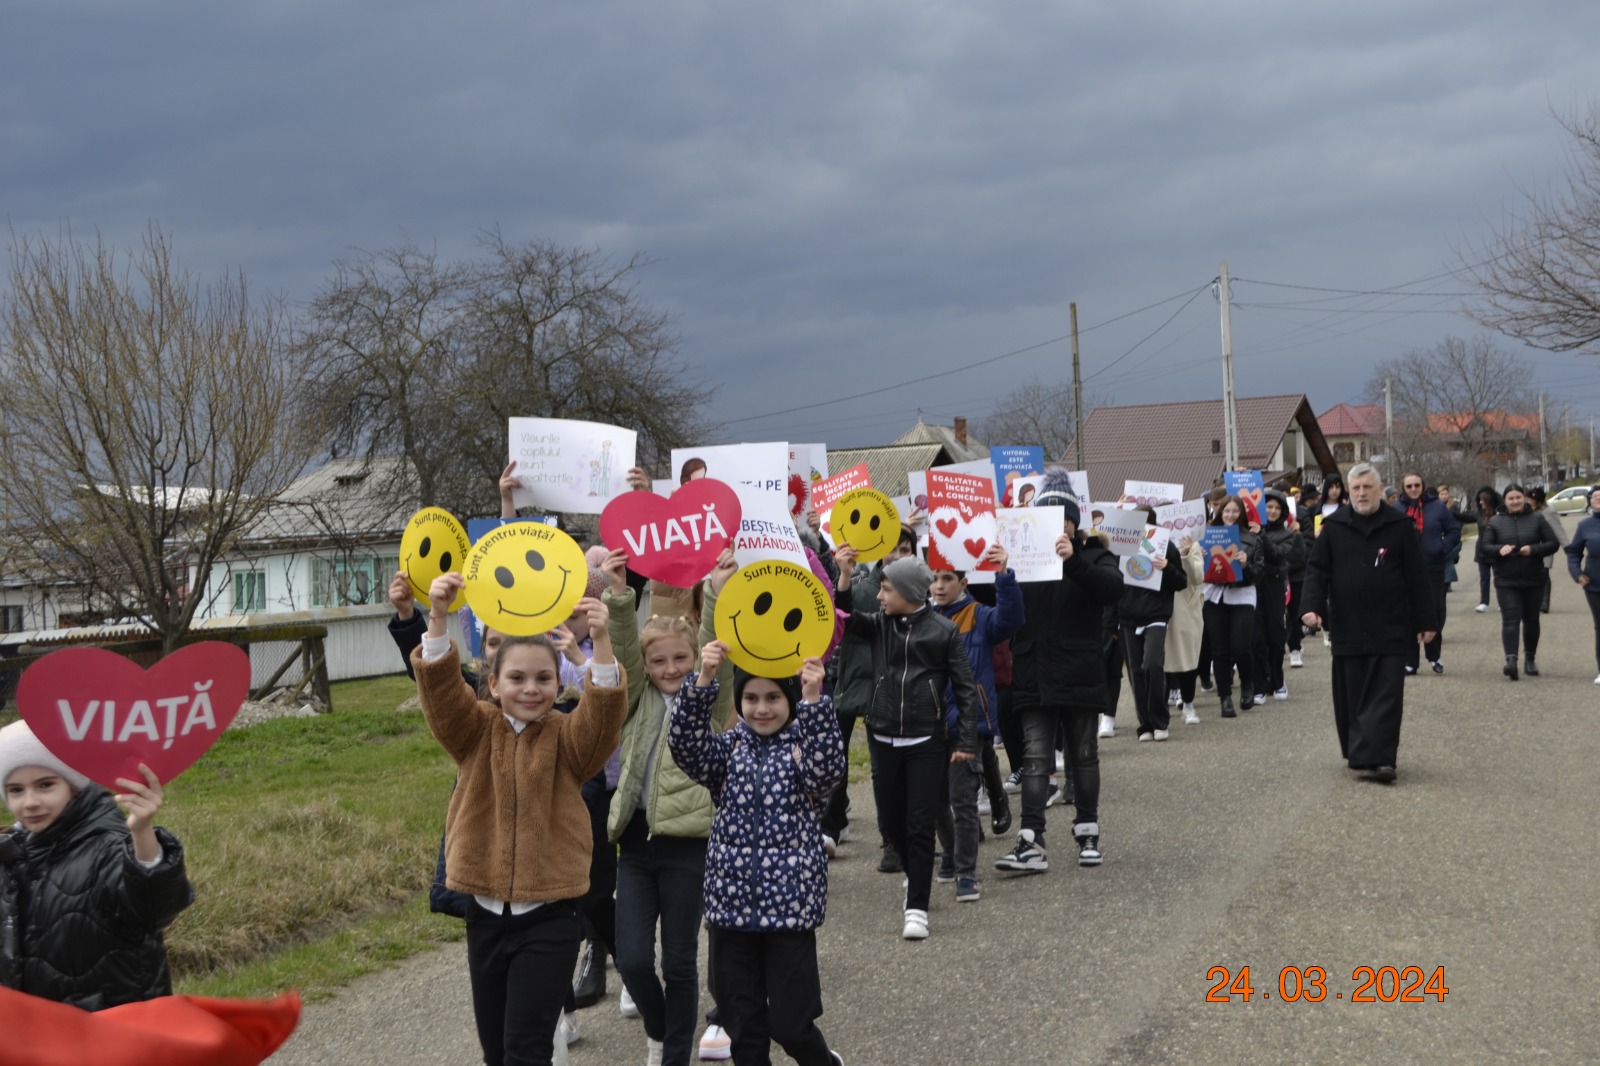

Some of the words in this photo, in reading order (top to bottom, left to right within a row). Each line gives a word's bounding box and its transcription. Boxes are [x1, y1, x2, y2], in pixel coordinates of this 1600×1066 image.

[766, 480, 782, 491] PE
[812, 470, 859, 494] EGALITATEA
[825, 480, 852, 496] ÎNCEPE
[932, 474, 984, 488] EGALITATEA
[945, 482, 975, 494] ÎNCEPE
[932, 490, 944, 498] LA
[946, 493, 992, 505] CONCEPȚIE
[1137, 484, 1168, 496] ALEGE
[840, 492, 856, 507] Sunt
[857, 491, 881, 502] pentru
[1160, 504, 1192, 519] ALEGE
[414, 512, 431, 528] Sunt
[432, 513, 457, 533] pentru
[622, 503, 728, 557] VIAȚĂ
[782, 525, 795, 538] PE
[737, 534, 801, 553] AMÂNDOI!
[467, 554, 483, 580] Sunt
[479, 529, 516, 555] pentru
[519, 526, 555, 542] viață!
[744, 564, 772, 582] Sunt
[775, 565, 813, 589] pentru
[811, 588, 829, 622] viață!
[57, 679, 217, 749] VIAȚĂ
